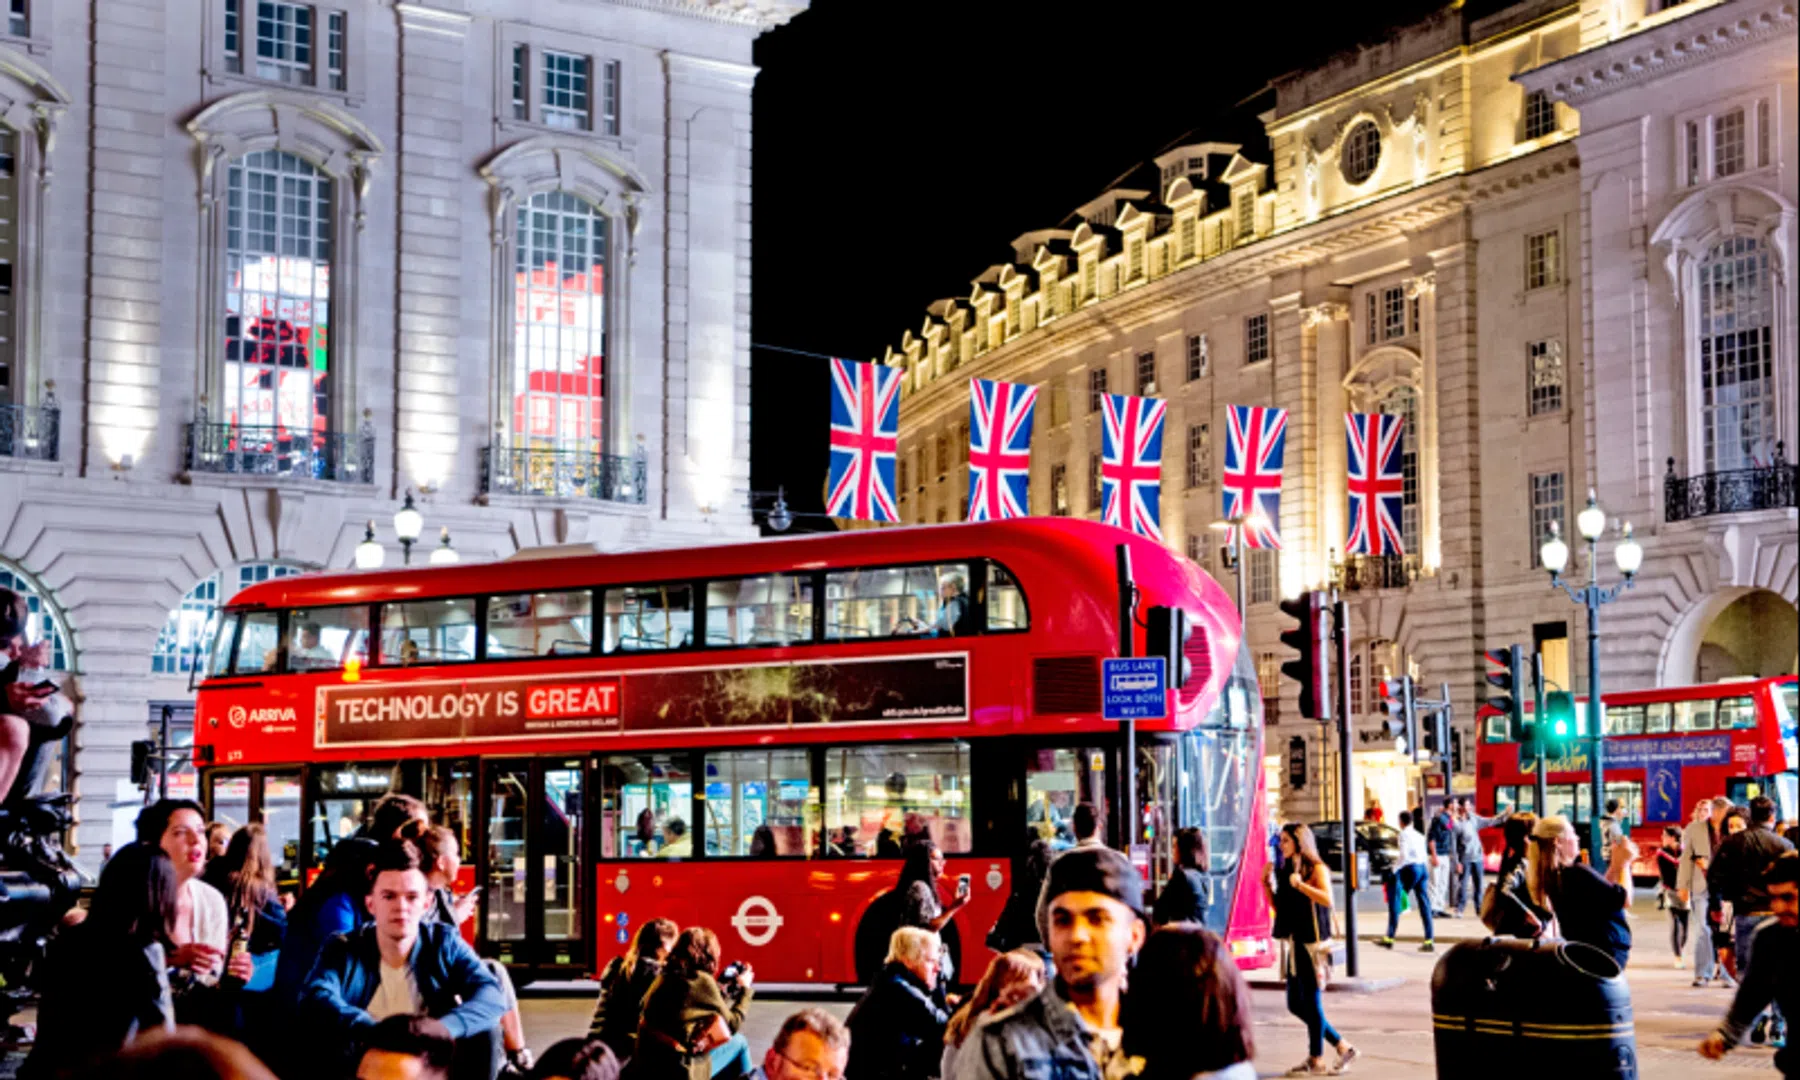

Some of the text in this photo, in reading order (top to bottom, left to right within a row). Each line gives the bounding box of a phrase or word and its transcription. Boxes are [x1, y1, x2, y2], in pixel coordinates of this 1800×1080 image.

[1109, 661, 1157, 672] BUS LANE
[335, 692, 491, 723] TECHNOLOGY
[497, 691, 519, 716] IS
[528, 686, 616, 715] GREAT
[1107, 693, 1162, 704] LOOK BOTH
[248, 707, 297, 723] ARRIVA
[1121, 706, 1148, 715] WAYS
[1661, 740, 1681, 752] END
[1685, 737, 1727, 750] MUSICAL
